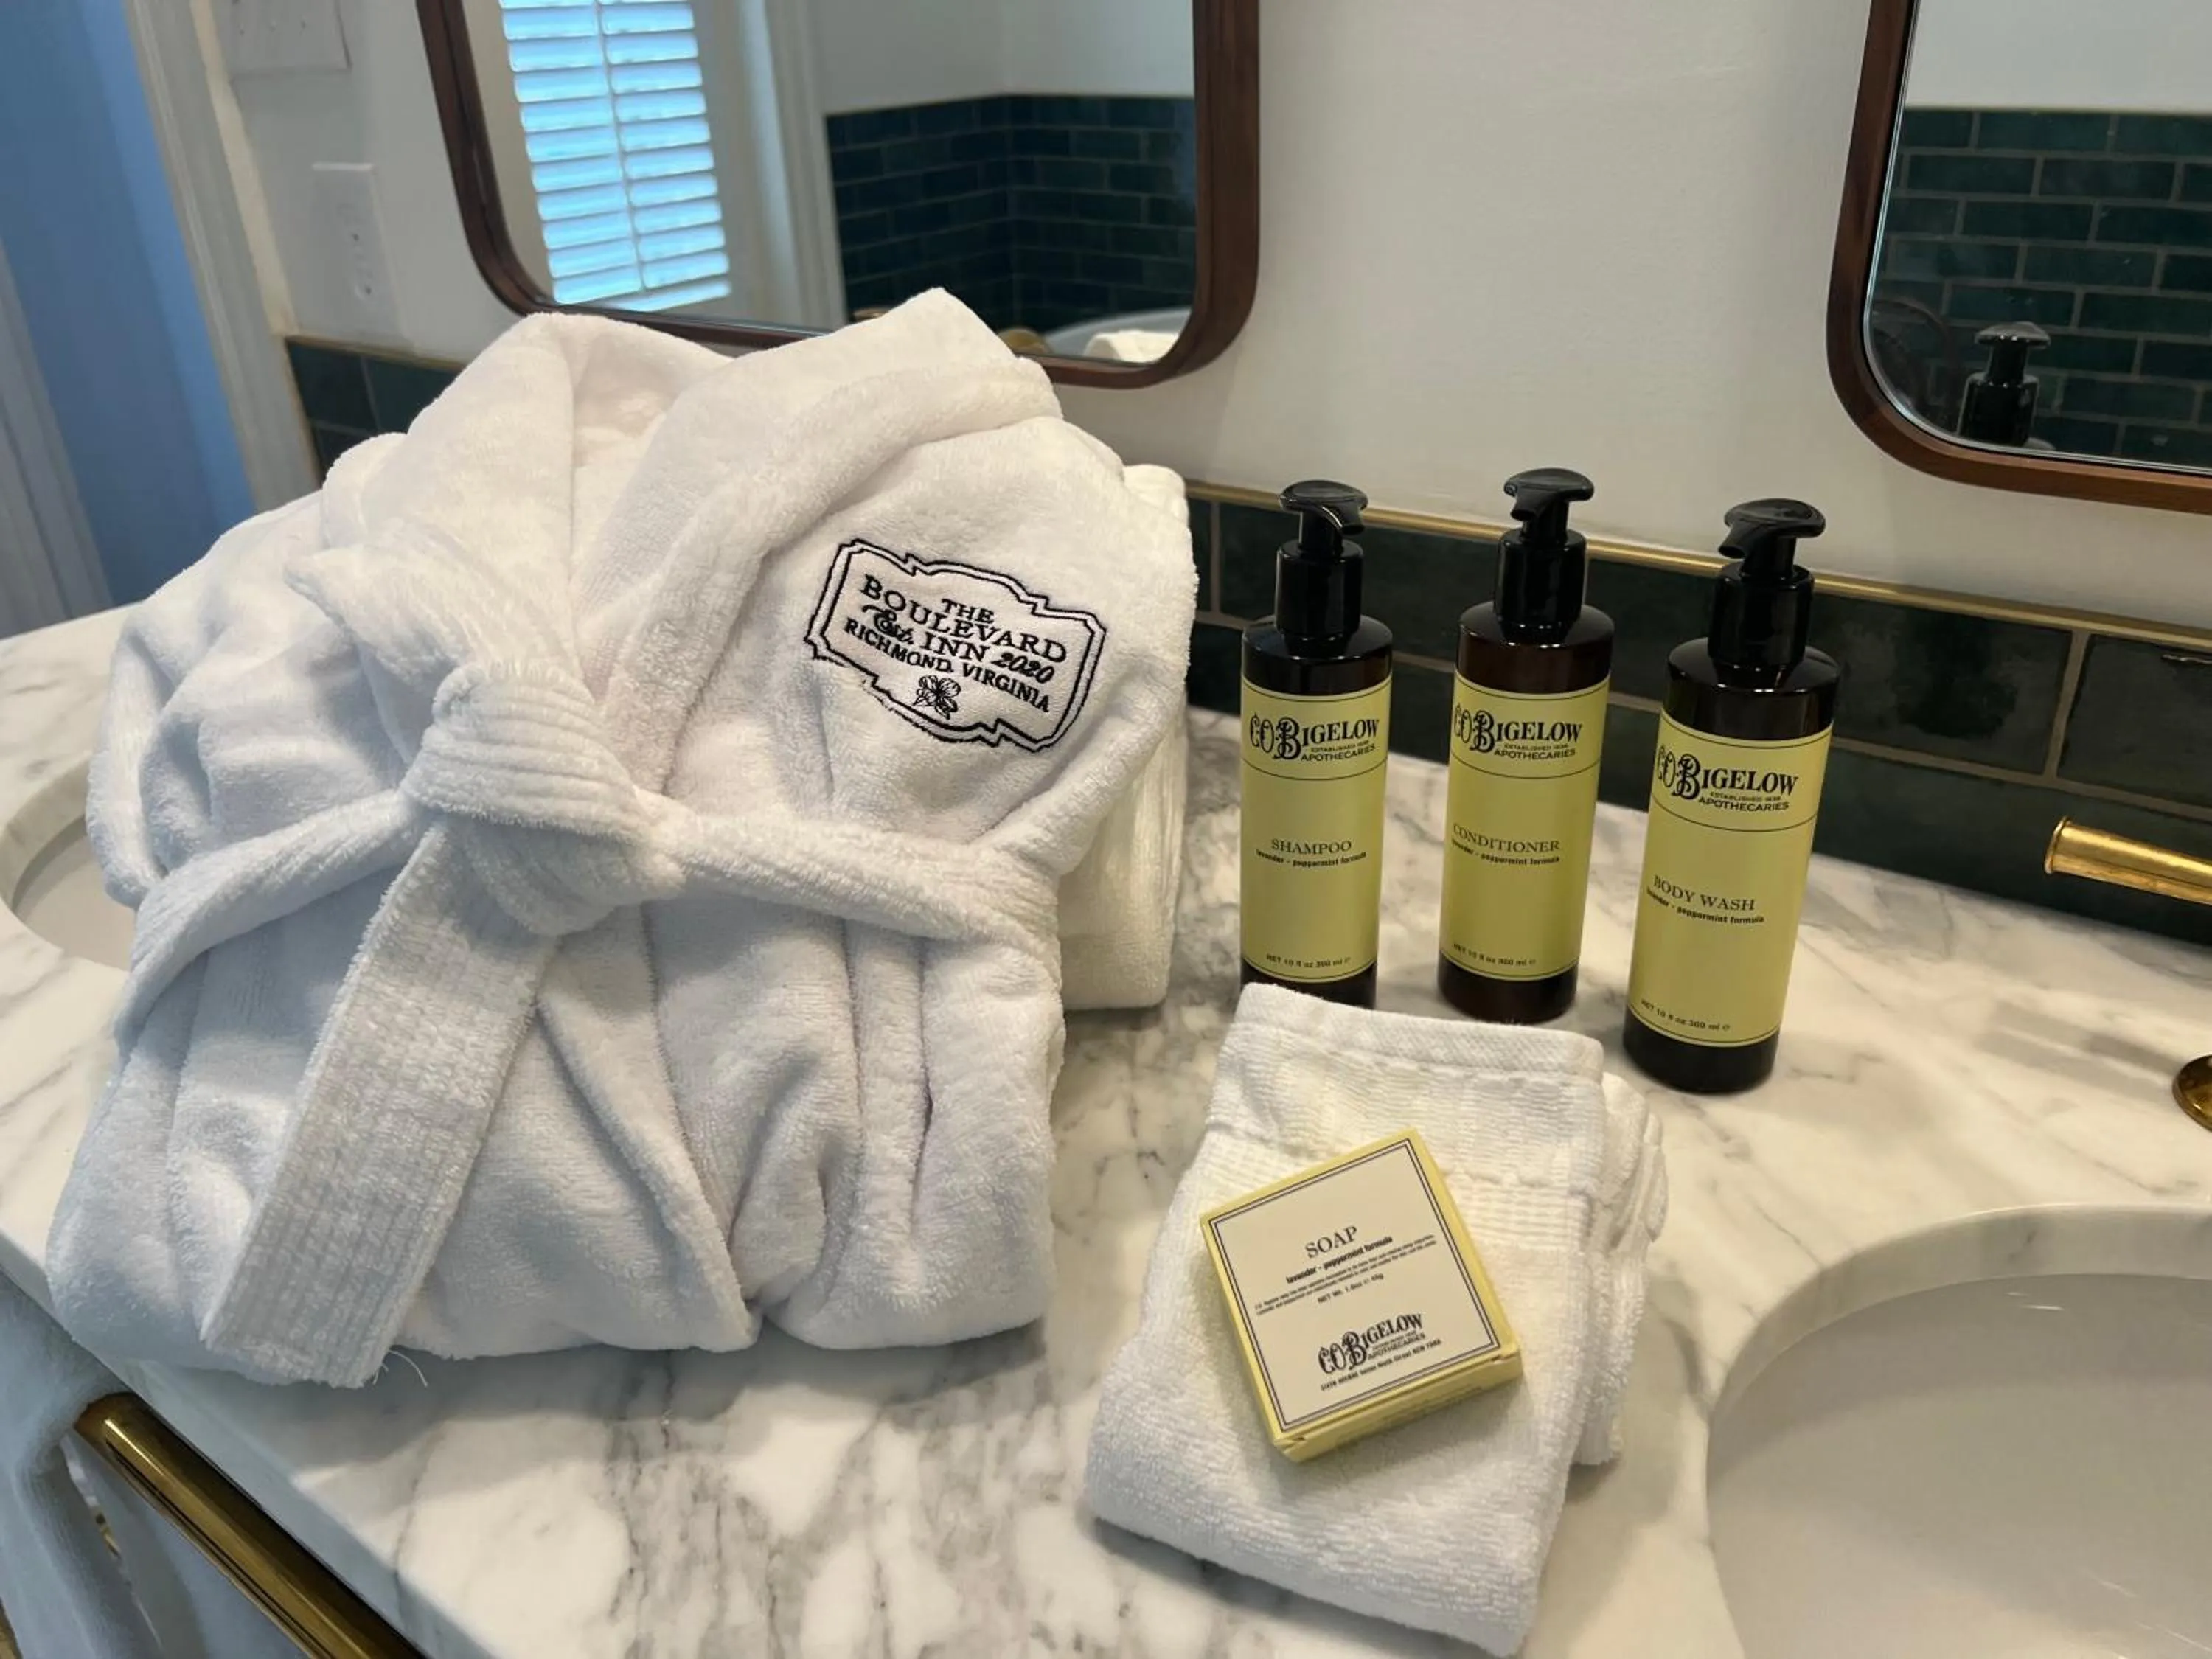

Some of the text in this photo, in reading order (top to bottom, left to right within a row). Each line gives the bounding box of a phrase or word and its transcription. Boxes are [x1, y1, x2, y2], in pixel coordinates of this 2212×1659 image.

[860, 574, 1066, 663] BOULEVARD
[942, 599, 994, 623] THE
[862, 605, 1055, 684] Est. INN 2020
[962, 663, 1050, 713] VIRGINIA
[1301, 742, 1376, 762] APOTHECARIES
[1494, 748, 1576, 760] APOTHECARIES
[1698, 796, 1790, 812] APOTHECARIES
[1271, 838, 1352, 855] SHAMPOO
[1453, 823, 1560, 853] CONDITIONER
[1653, 874, 1755, 911] BODY WASH
[1305, 1226, 1357, 1259] SOAP
